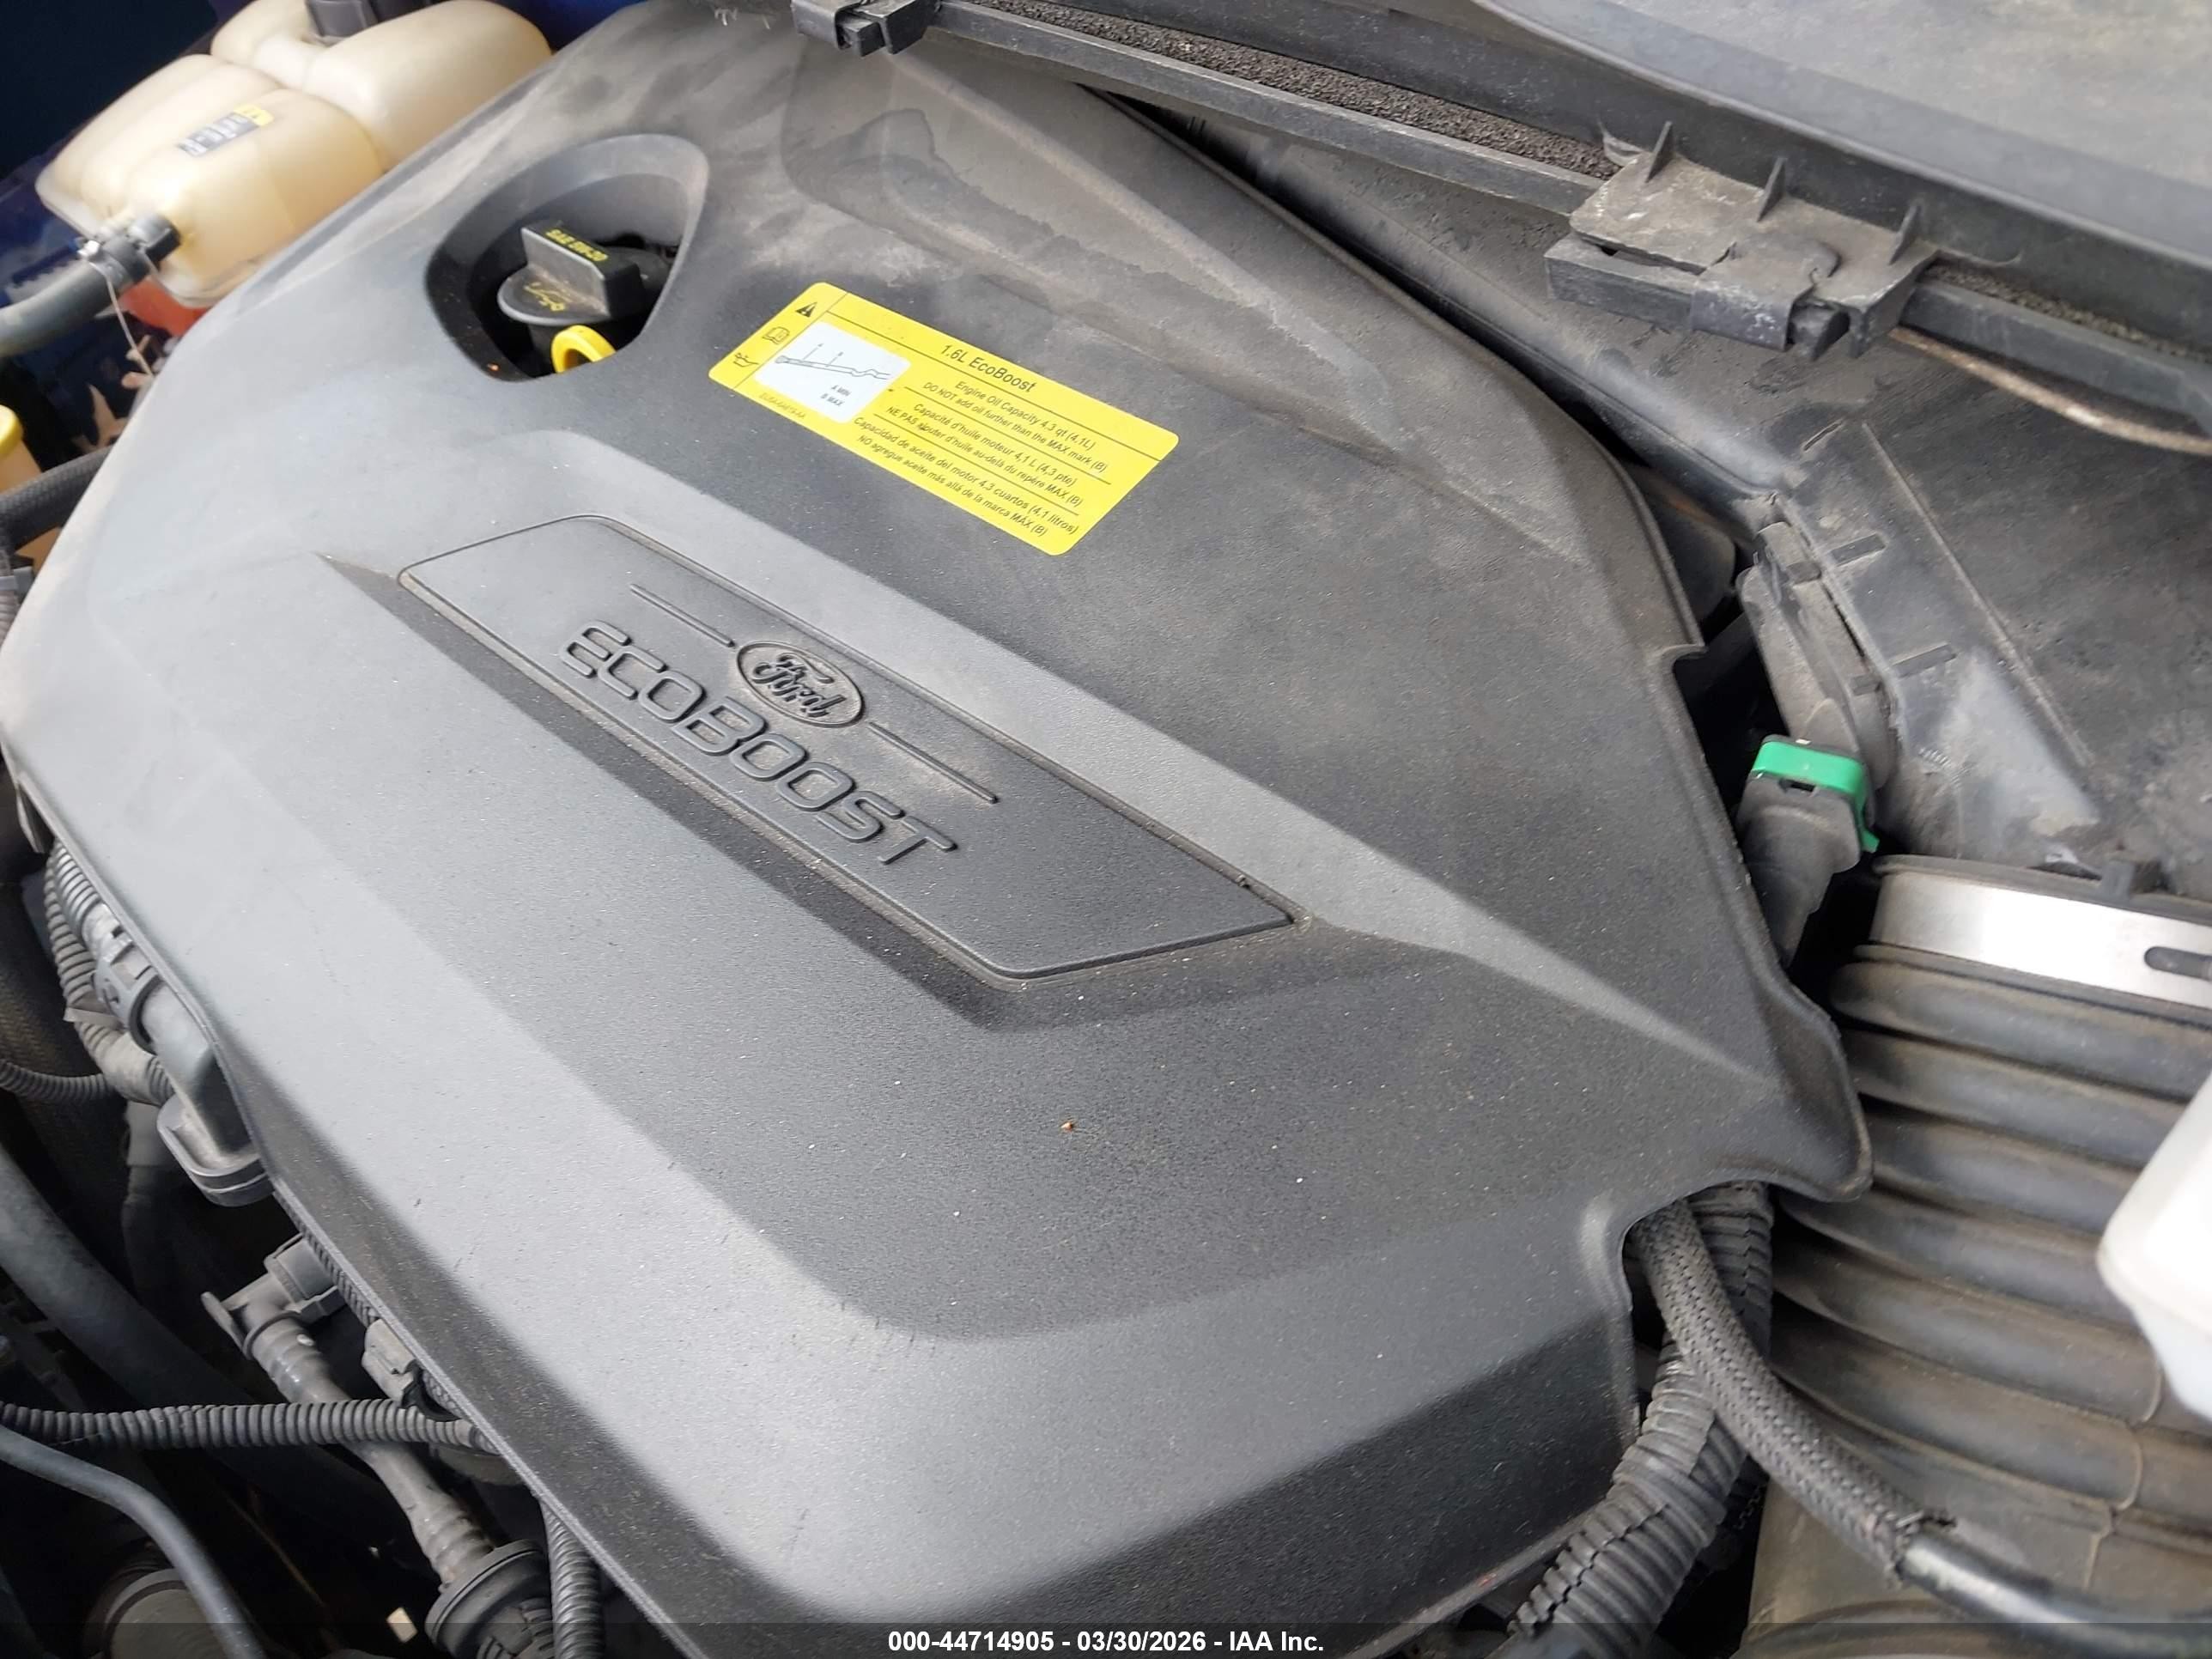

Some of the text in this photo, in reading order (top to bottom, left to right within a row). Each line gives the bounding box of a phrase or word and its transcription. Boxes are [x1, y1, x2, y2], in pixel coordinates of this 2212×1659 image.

[941, 345, 1036, 392] 1.6L EcoBoost
[922, 382, 939, 392] DO
[936, 389, 957, 400] NOT
[955, 398, 974, 408] add
[983, 410, 1013, 426] further
[1012, 424, 1032, 436] than
[1031, 433, 1047, 443] the
[1047, 440, 1070, 453] MAX
[1068, 452, 1092, 465] mark
[1091, 461, 1108, 472] (B)
[955, 381, 986, 399] Engine
[987, 396, 1003, 406] Oil
[1000, 402, 1041, 425] Capacity
[1054, 428, 1069, 439] qt
[752, 653, 846, 718] Ford
[559, 620, 957, 865] ECOBOOST
